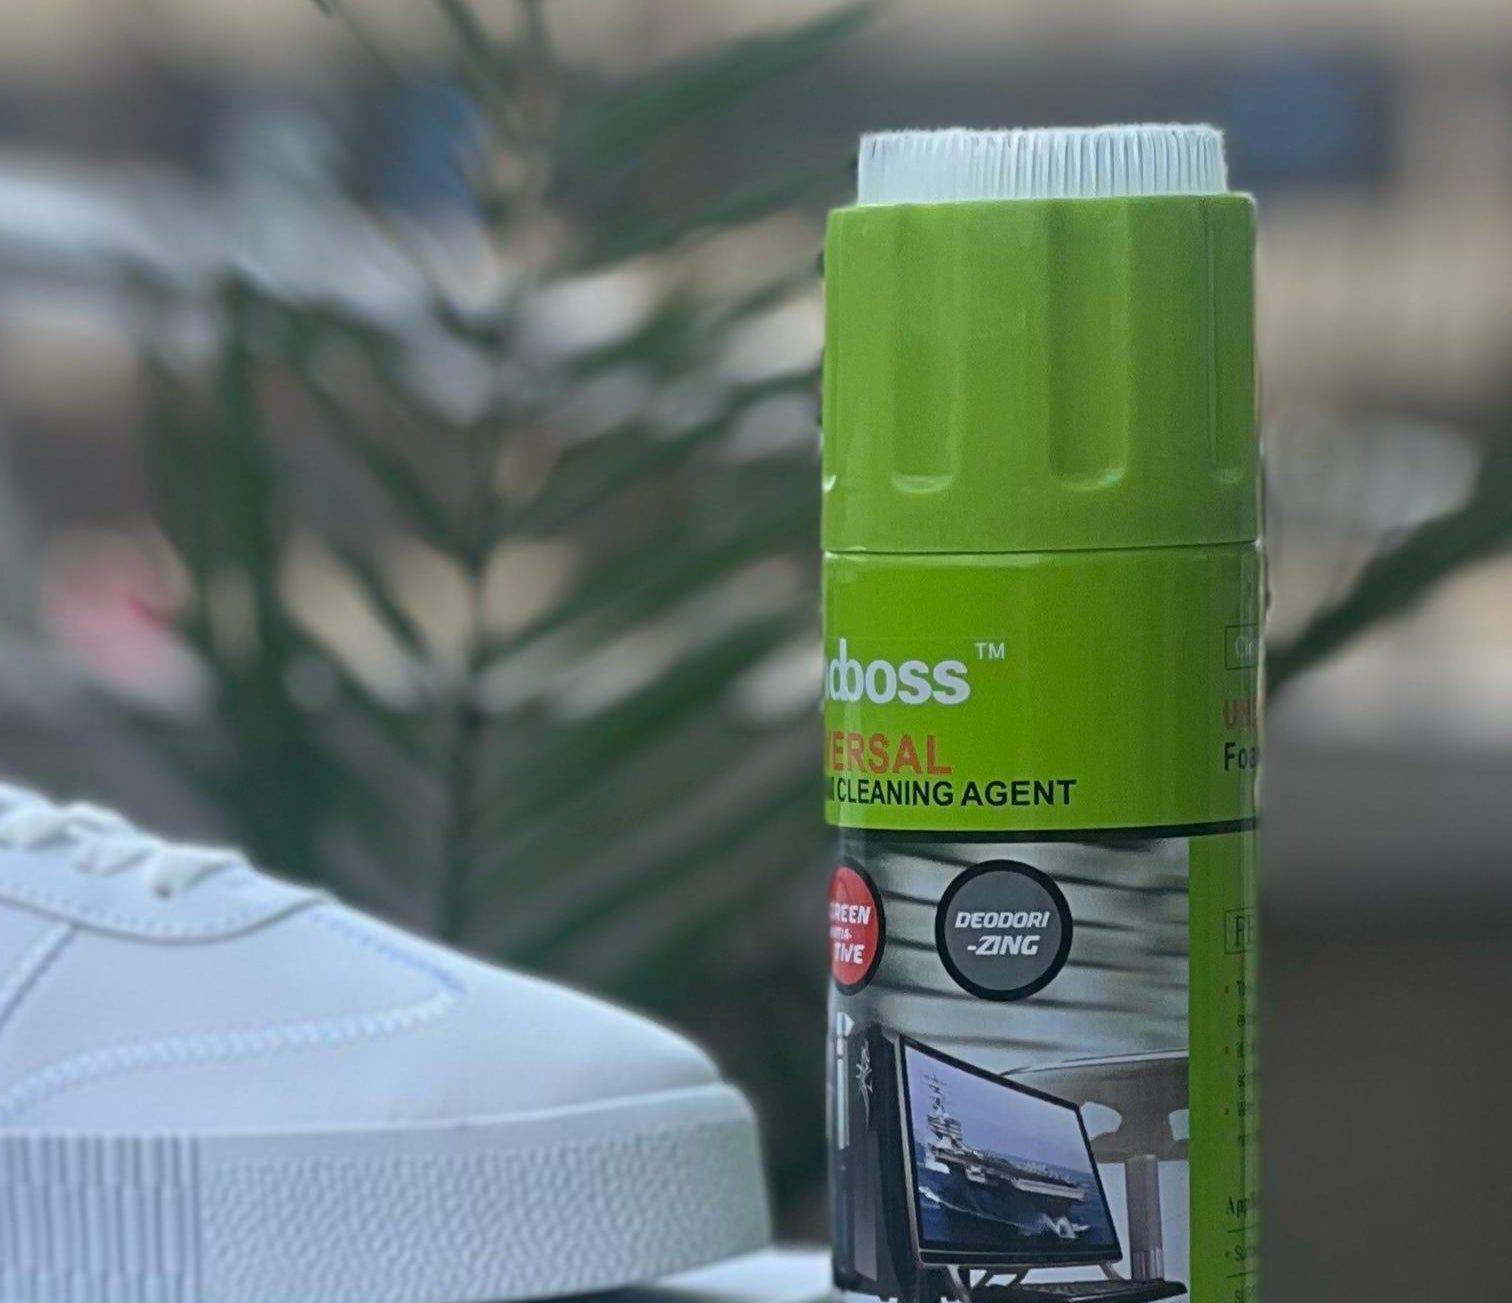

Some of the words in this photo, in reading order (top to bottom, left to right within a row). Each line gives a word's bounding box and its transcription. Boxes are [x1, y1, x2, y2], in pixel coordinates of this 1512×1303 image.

[826, 638, 971, 704] dboss
[829, 730, 952, 775] ERSAL
[838, 777, 954, 806] CLEANING
[961, 779, 1077, 807] AGENT
[830, 903, 871, 925] REEN
[955, 910, 1049, 929] DEODORI
[967, 934, 1040, 956] -ZING
